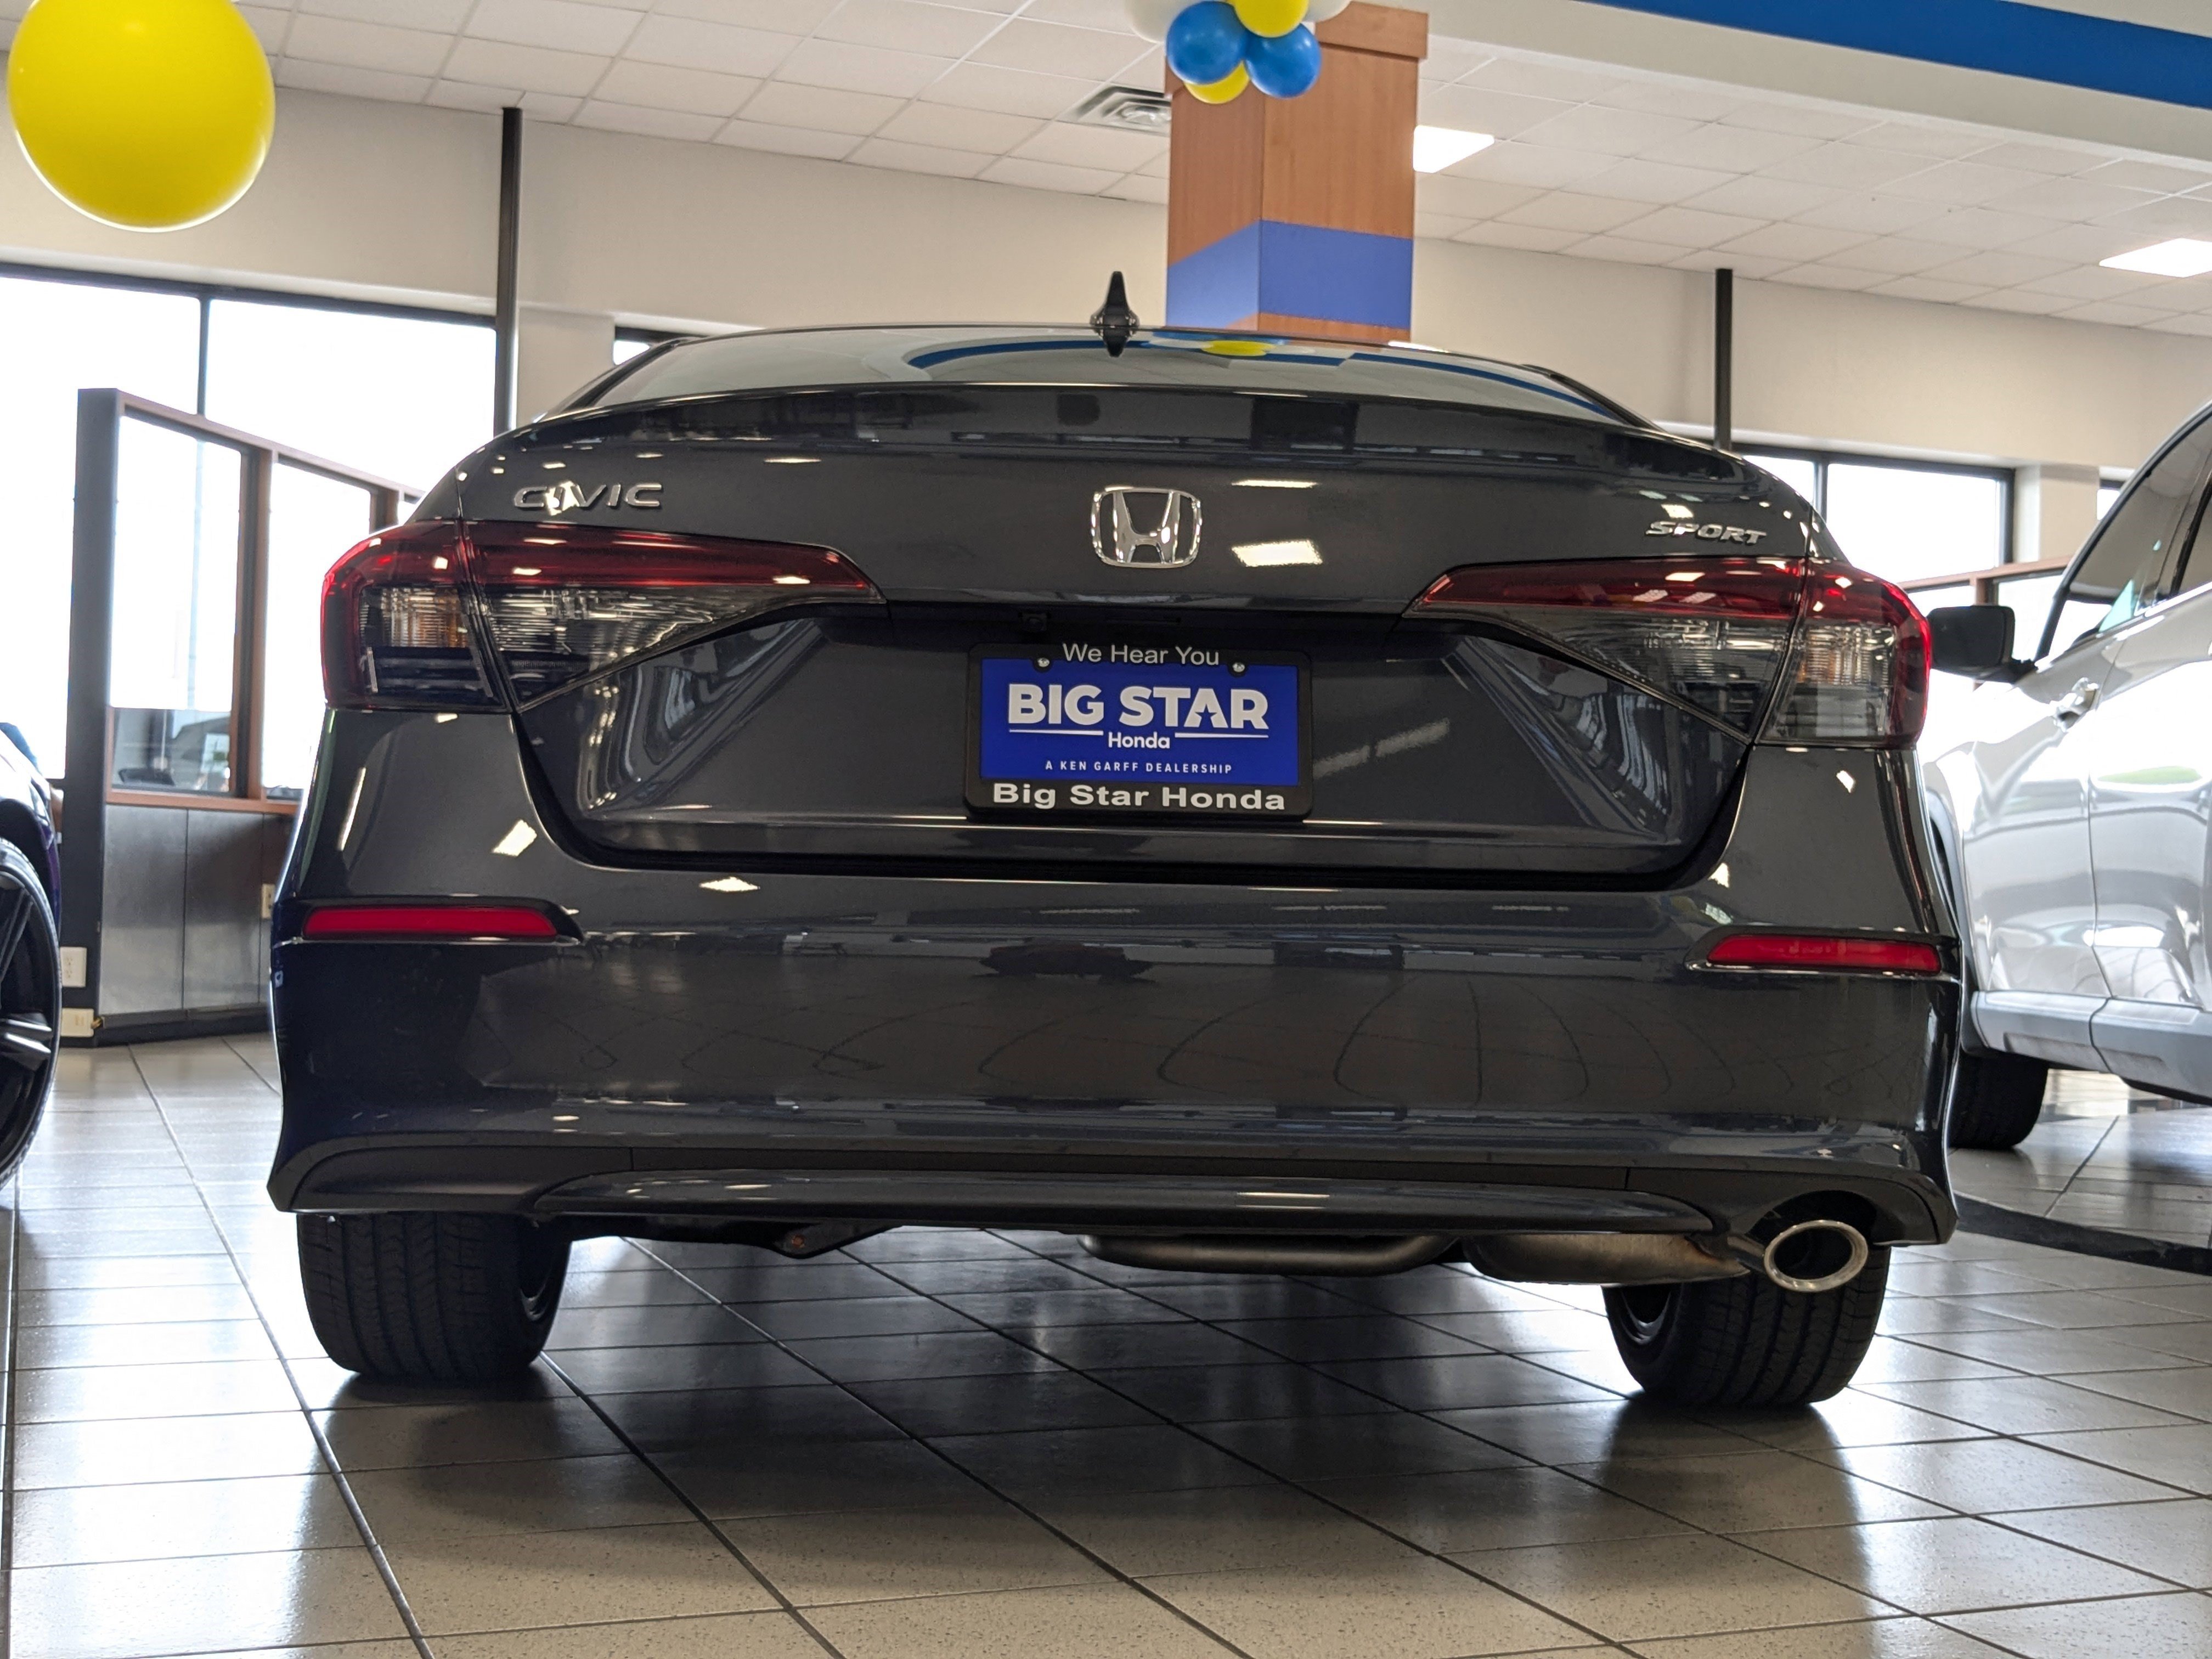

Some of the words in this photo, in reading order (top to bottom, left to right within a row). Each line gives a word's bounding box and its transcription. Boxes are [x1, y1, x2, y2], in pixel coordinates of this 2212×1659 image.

[514, 483, 662, 510] CIVIC
[1646, 521, 1767, 544] SPORT
[1063, 642, 1102, 663] We
[1111, 644, 1169, 664] Hear
[1175, 646, 1219, 665] You
[1008, 684, 1104, 725] BIG
[1119, 686, 1269, 730] STAR
[1108, 731, 1170, 749] Honda
[1045, 760, 1053, 770] A
[1060, 760, 1087, 771] KEN
[1094, 761, 1139, 772] GARFF
[1146, 762, 1232, 774] DEALERSHIP
[994, 783, 1056, 809] Big
[1070, 785, 1150, 806] Star
[1162, 787, 1285, 810] Honda
